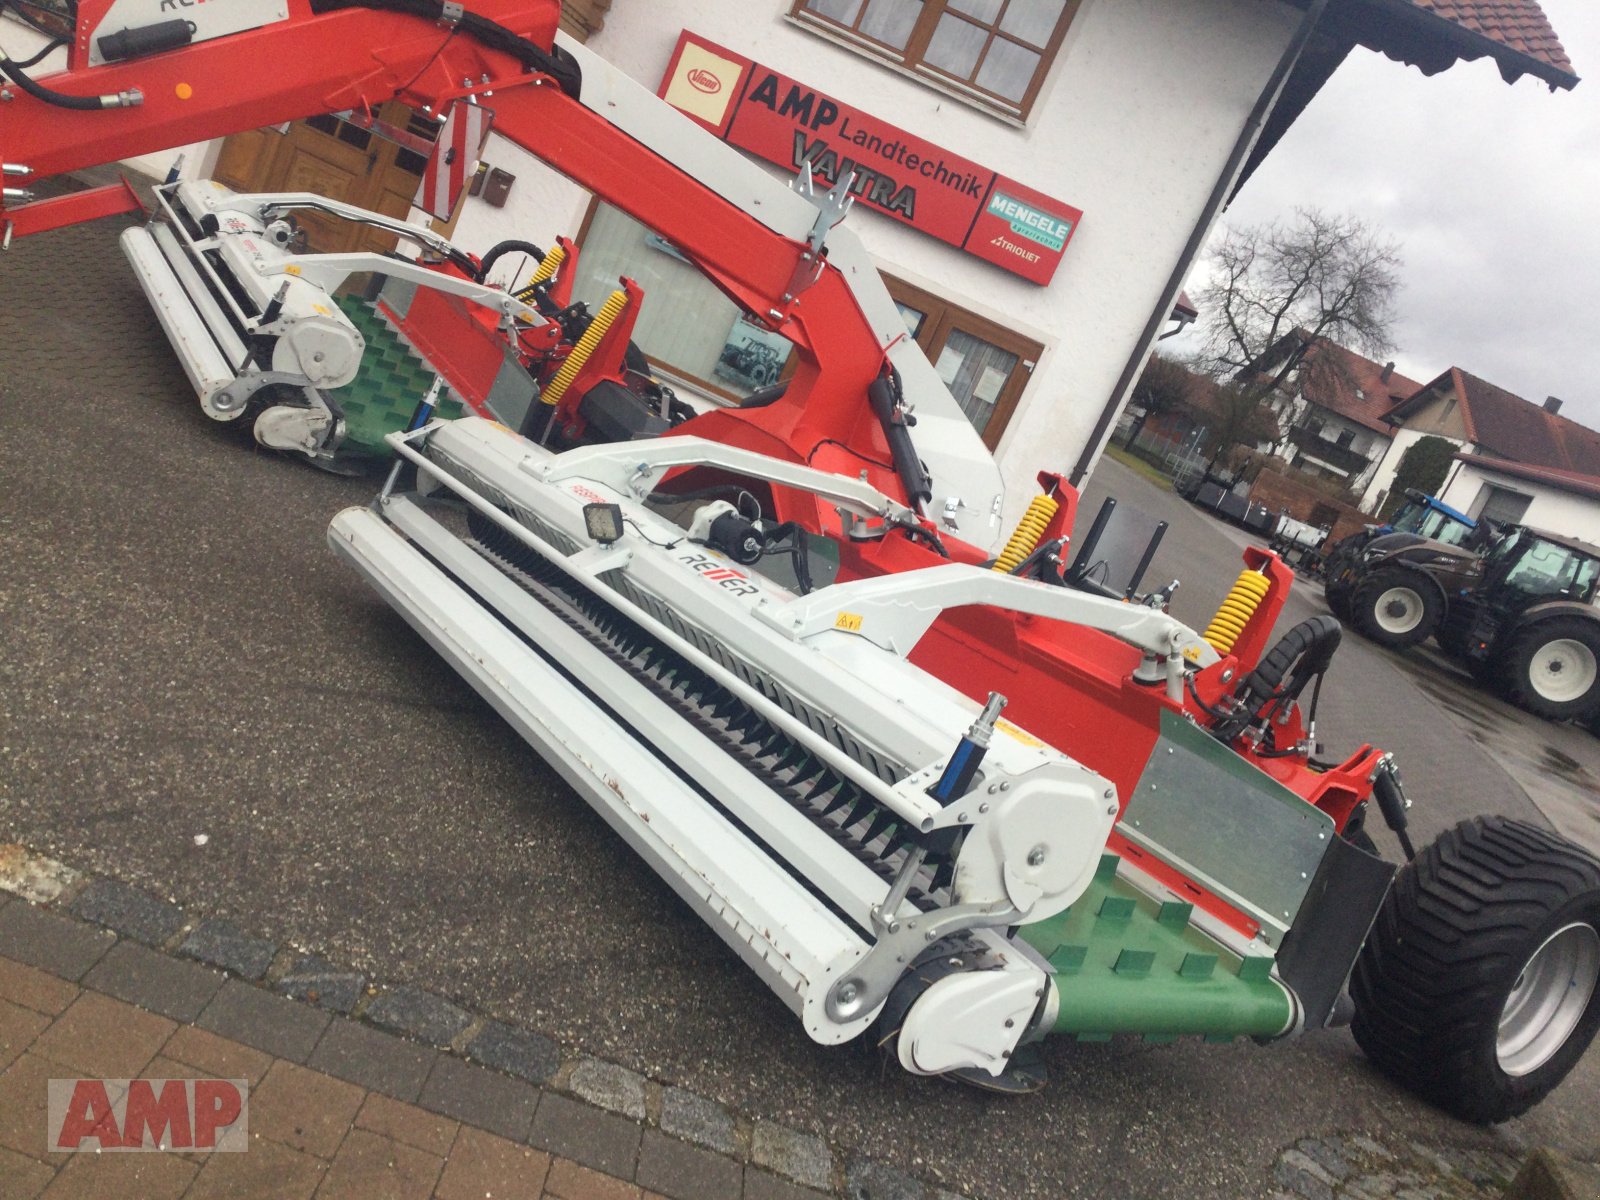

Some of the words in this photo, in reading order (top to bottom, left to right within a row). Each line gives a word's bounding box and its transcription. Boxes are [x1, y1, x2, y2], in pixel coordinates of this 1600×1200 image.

[689, 68, 720, 92] Vicon
[748, 74, 838, 131] AMP
[838, 117, 983, 199] Landtechnik
[991, 195, 1068, 240] MENGELE
[1000, 239, 1041, 263] TRIOLIET
[679, 554, 759, 597] REITER
